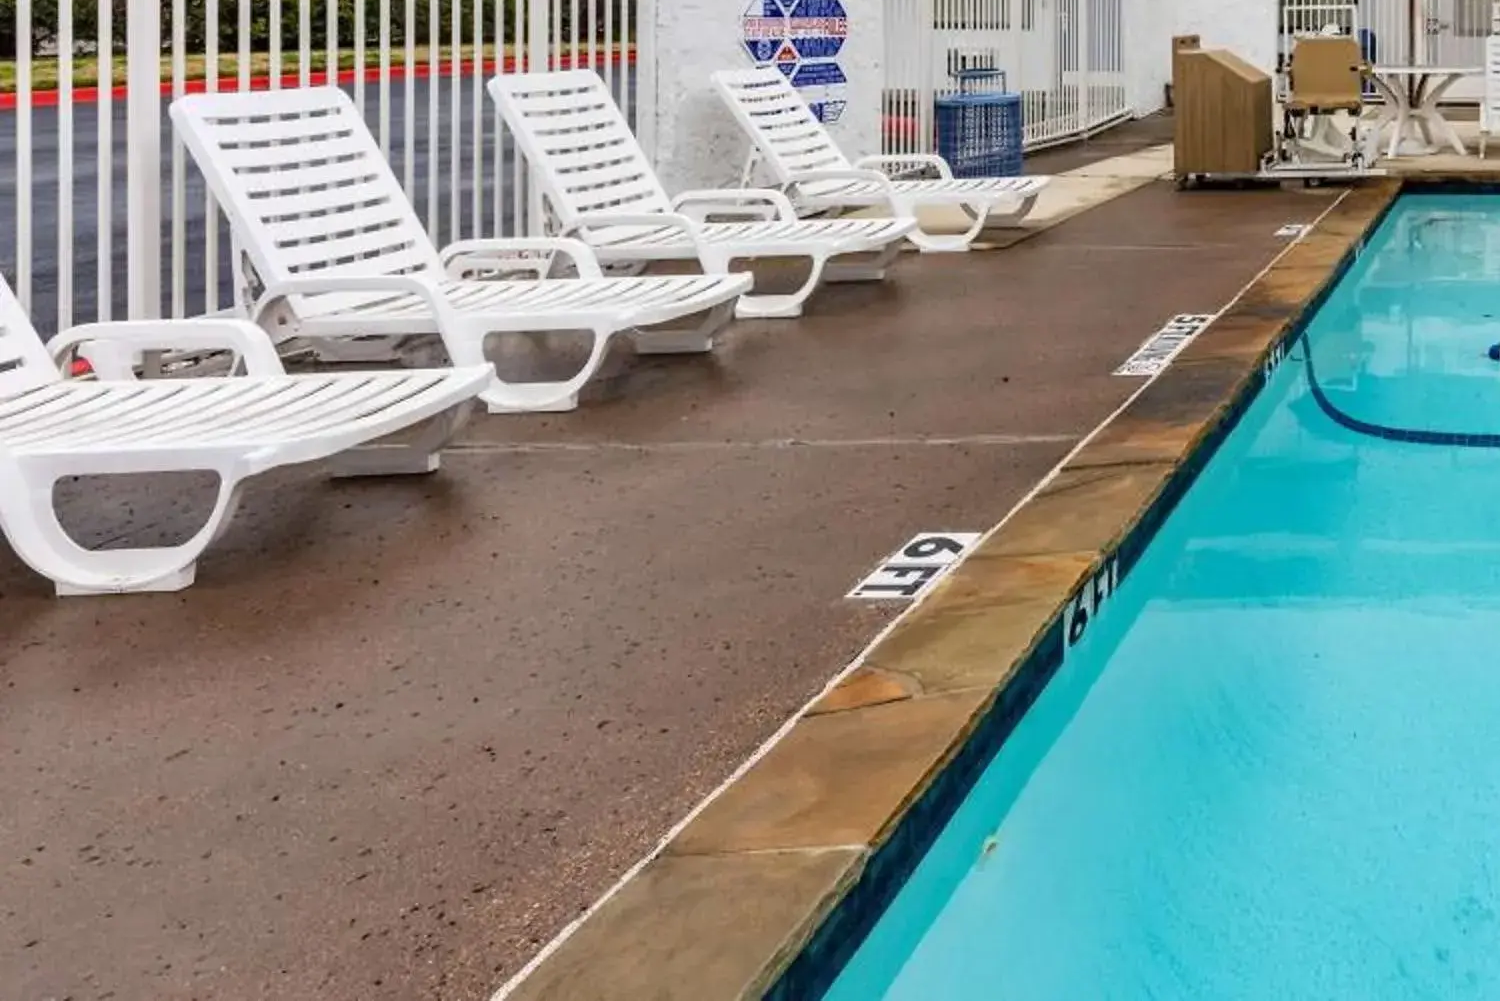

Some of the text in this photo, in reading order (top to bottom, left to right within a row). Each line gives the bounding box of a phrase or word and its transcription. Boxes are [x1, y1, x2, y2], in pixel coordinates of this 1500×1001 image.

[853, 536, 964, 596] 6 FT
[1069, 556, 1115, 647] 6 FT
